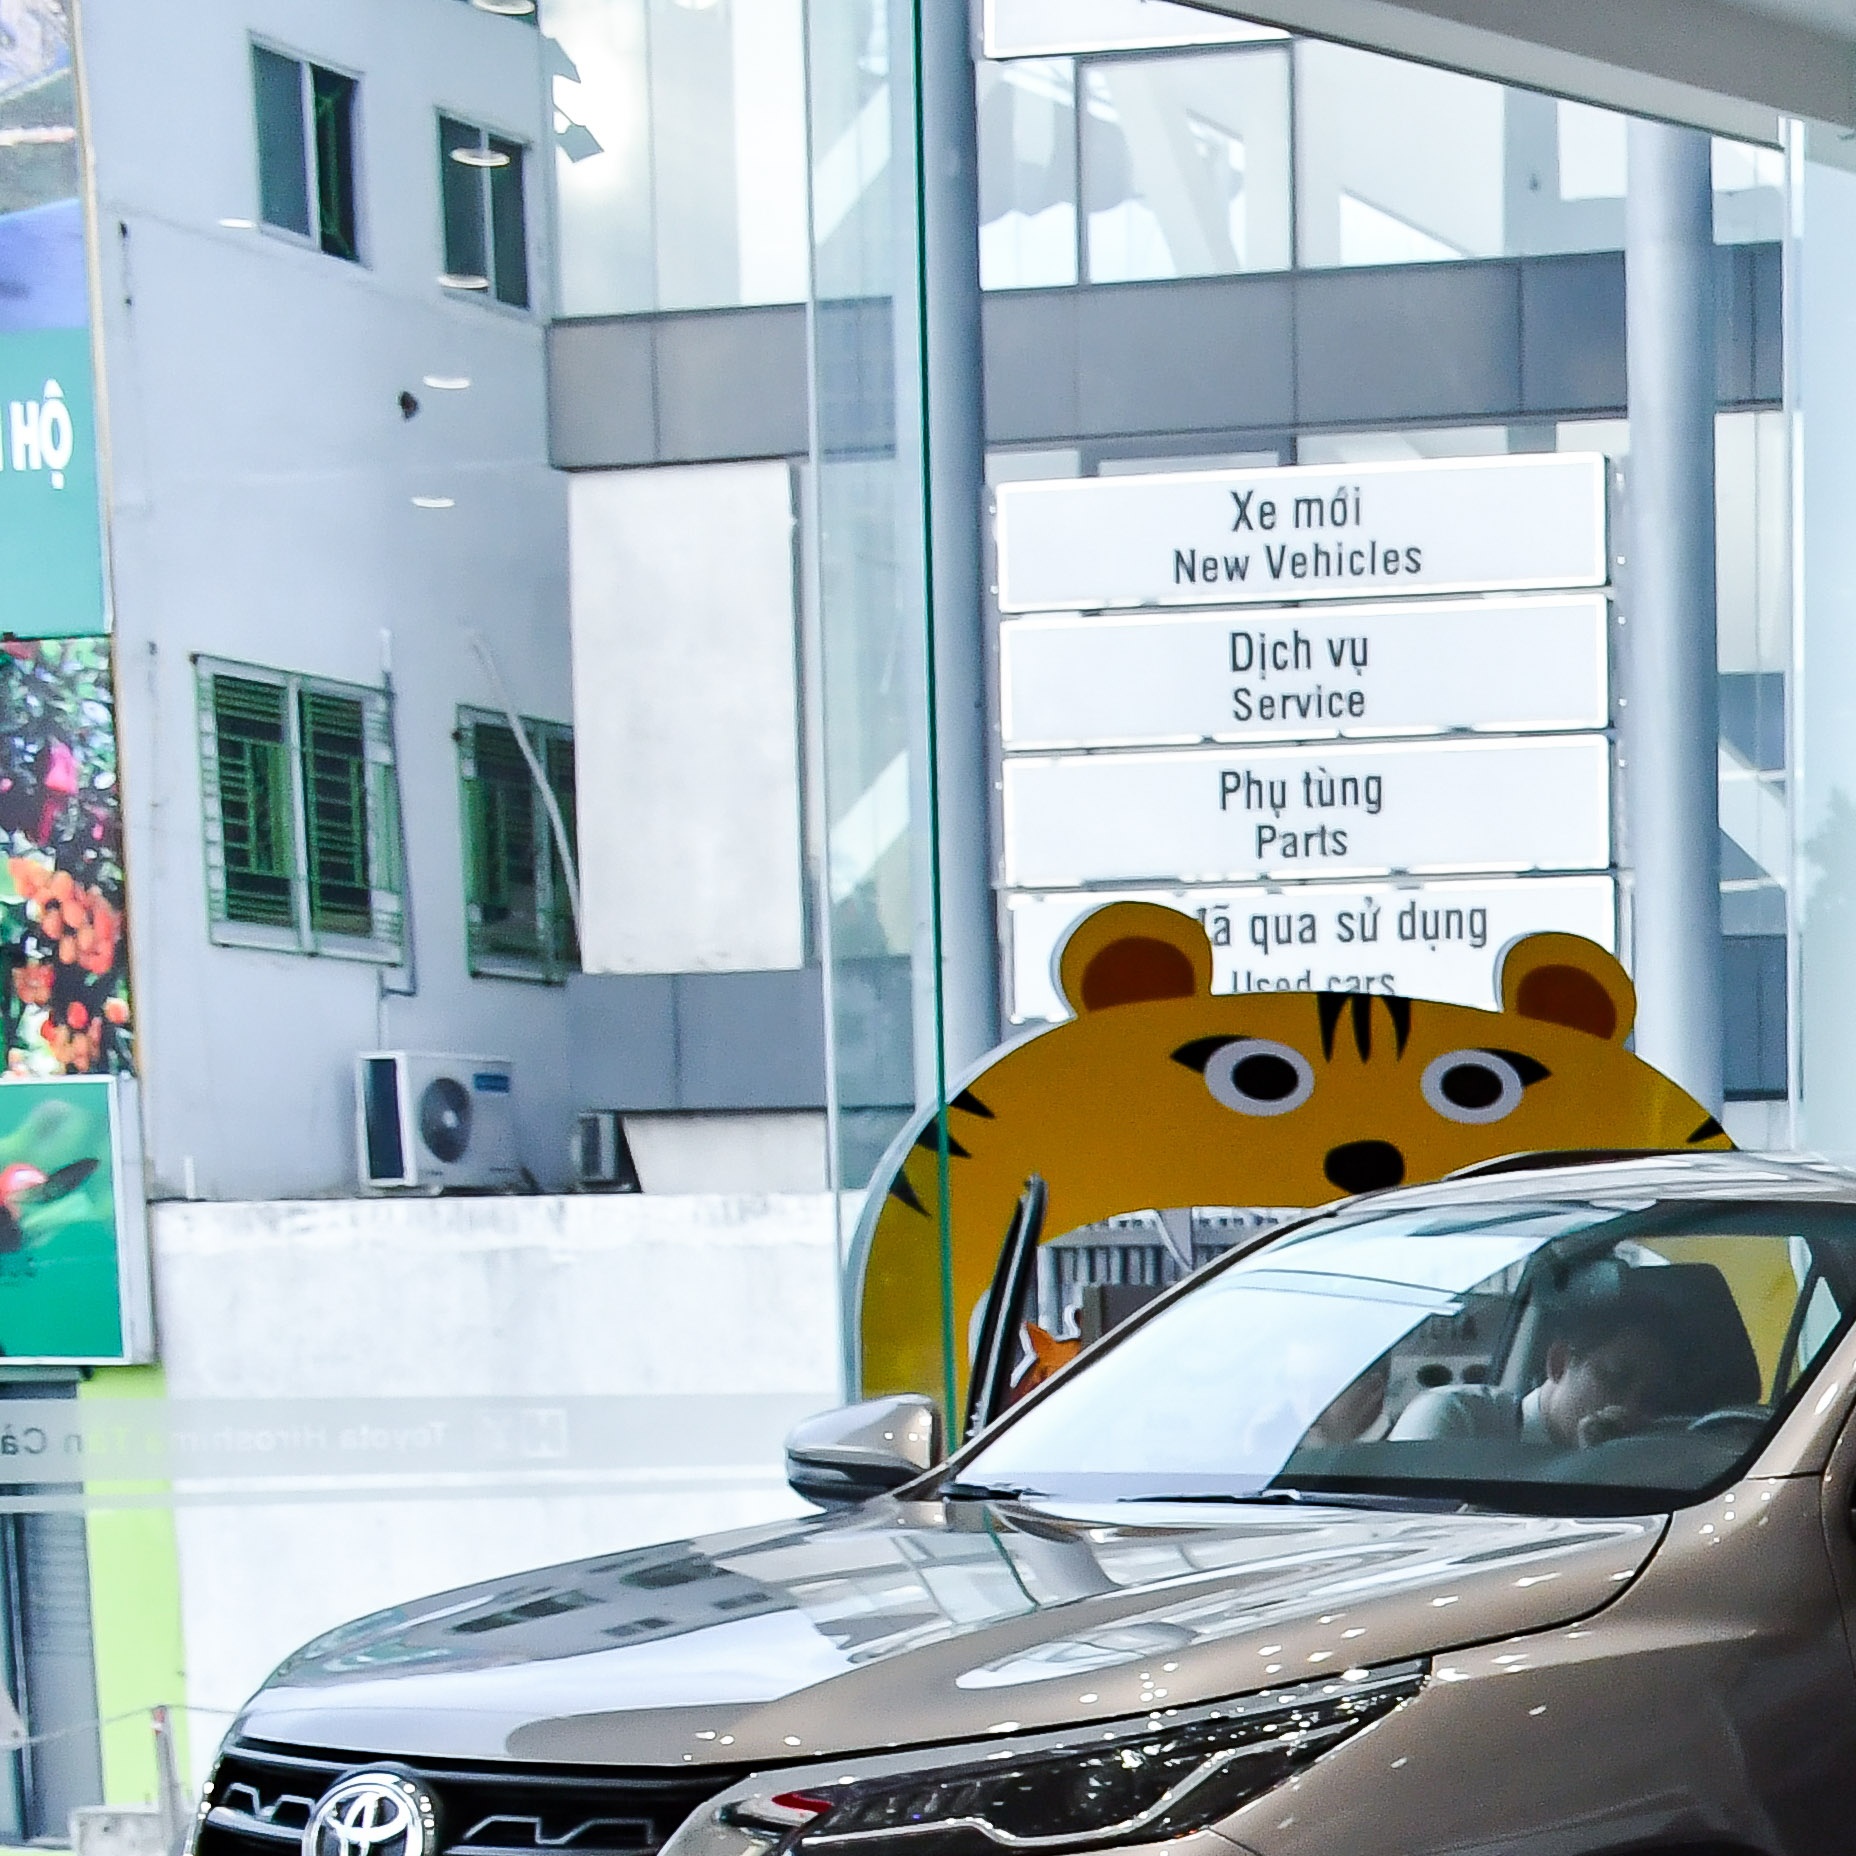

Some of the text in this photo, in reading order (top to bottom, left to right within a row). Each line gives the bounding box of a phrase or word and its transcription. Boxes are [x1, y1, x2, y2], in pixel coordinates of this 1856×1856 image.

[10, 378, 74, 490] HỘ
[1230, 485, 1361, 532] Xe mới
[1173, 540, 1422, 584] New Vehicles
[1229, 628, 1368, 680] Dịch vụ
[1233, 684, 1365, 722] Service
[1219, 766, 1383, 818] Phụ tùng
[1256, 824, 1348, 859] Parts
[1250, 912, 1317, 955] qua
[1337, 896, 1381, 943] sử
[1399, 900, 1488, 952] dụng
